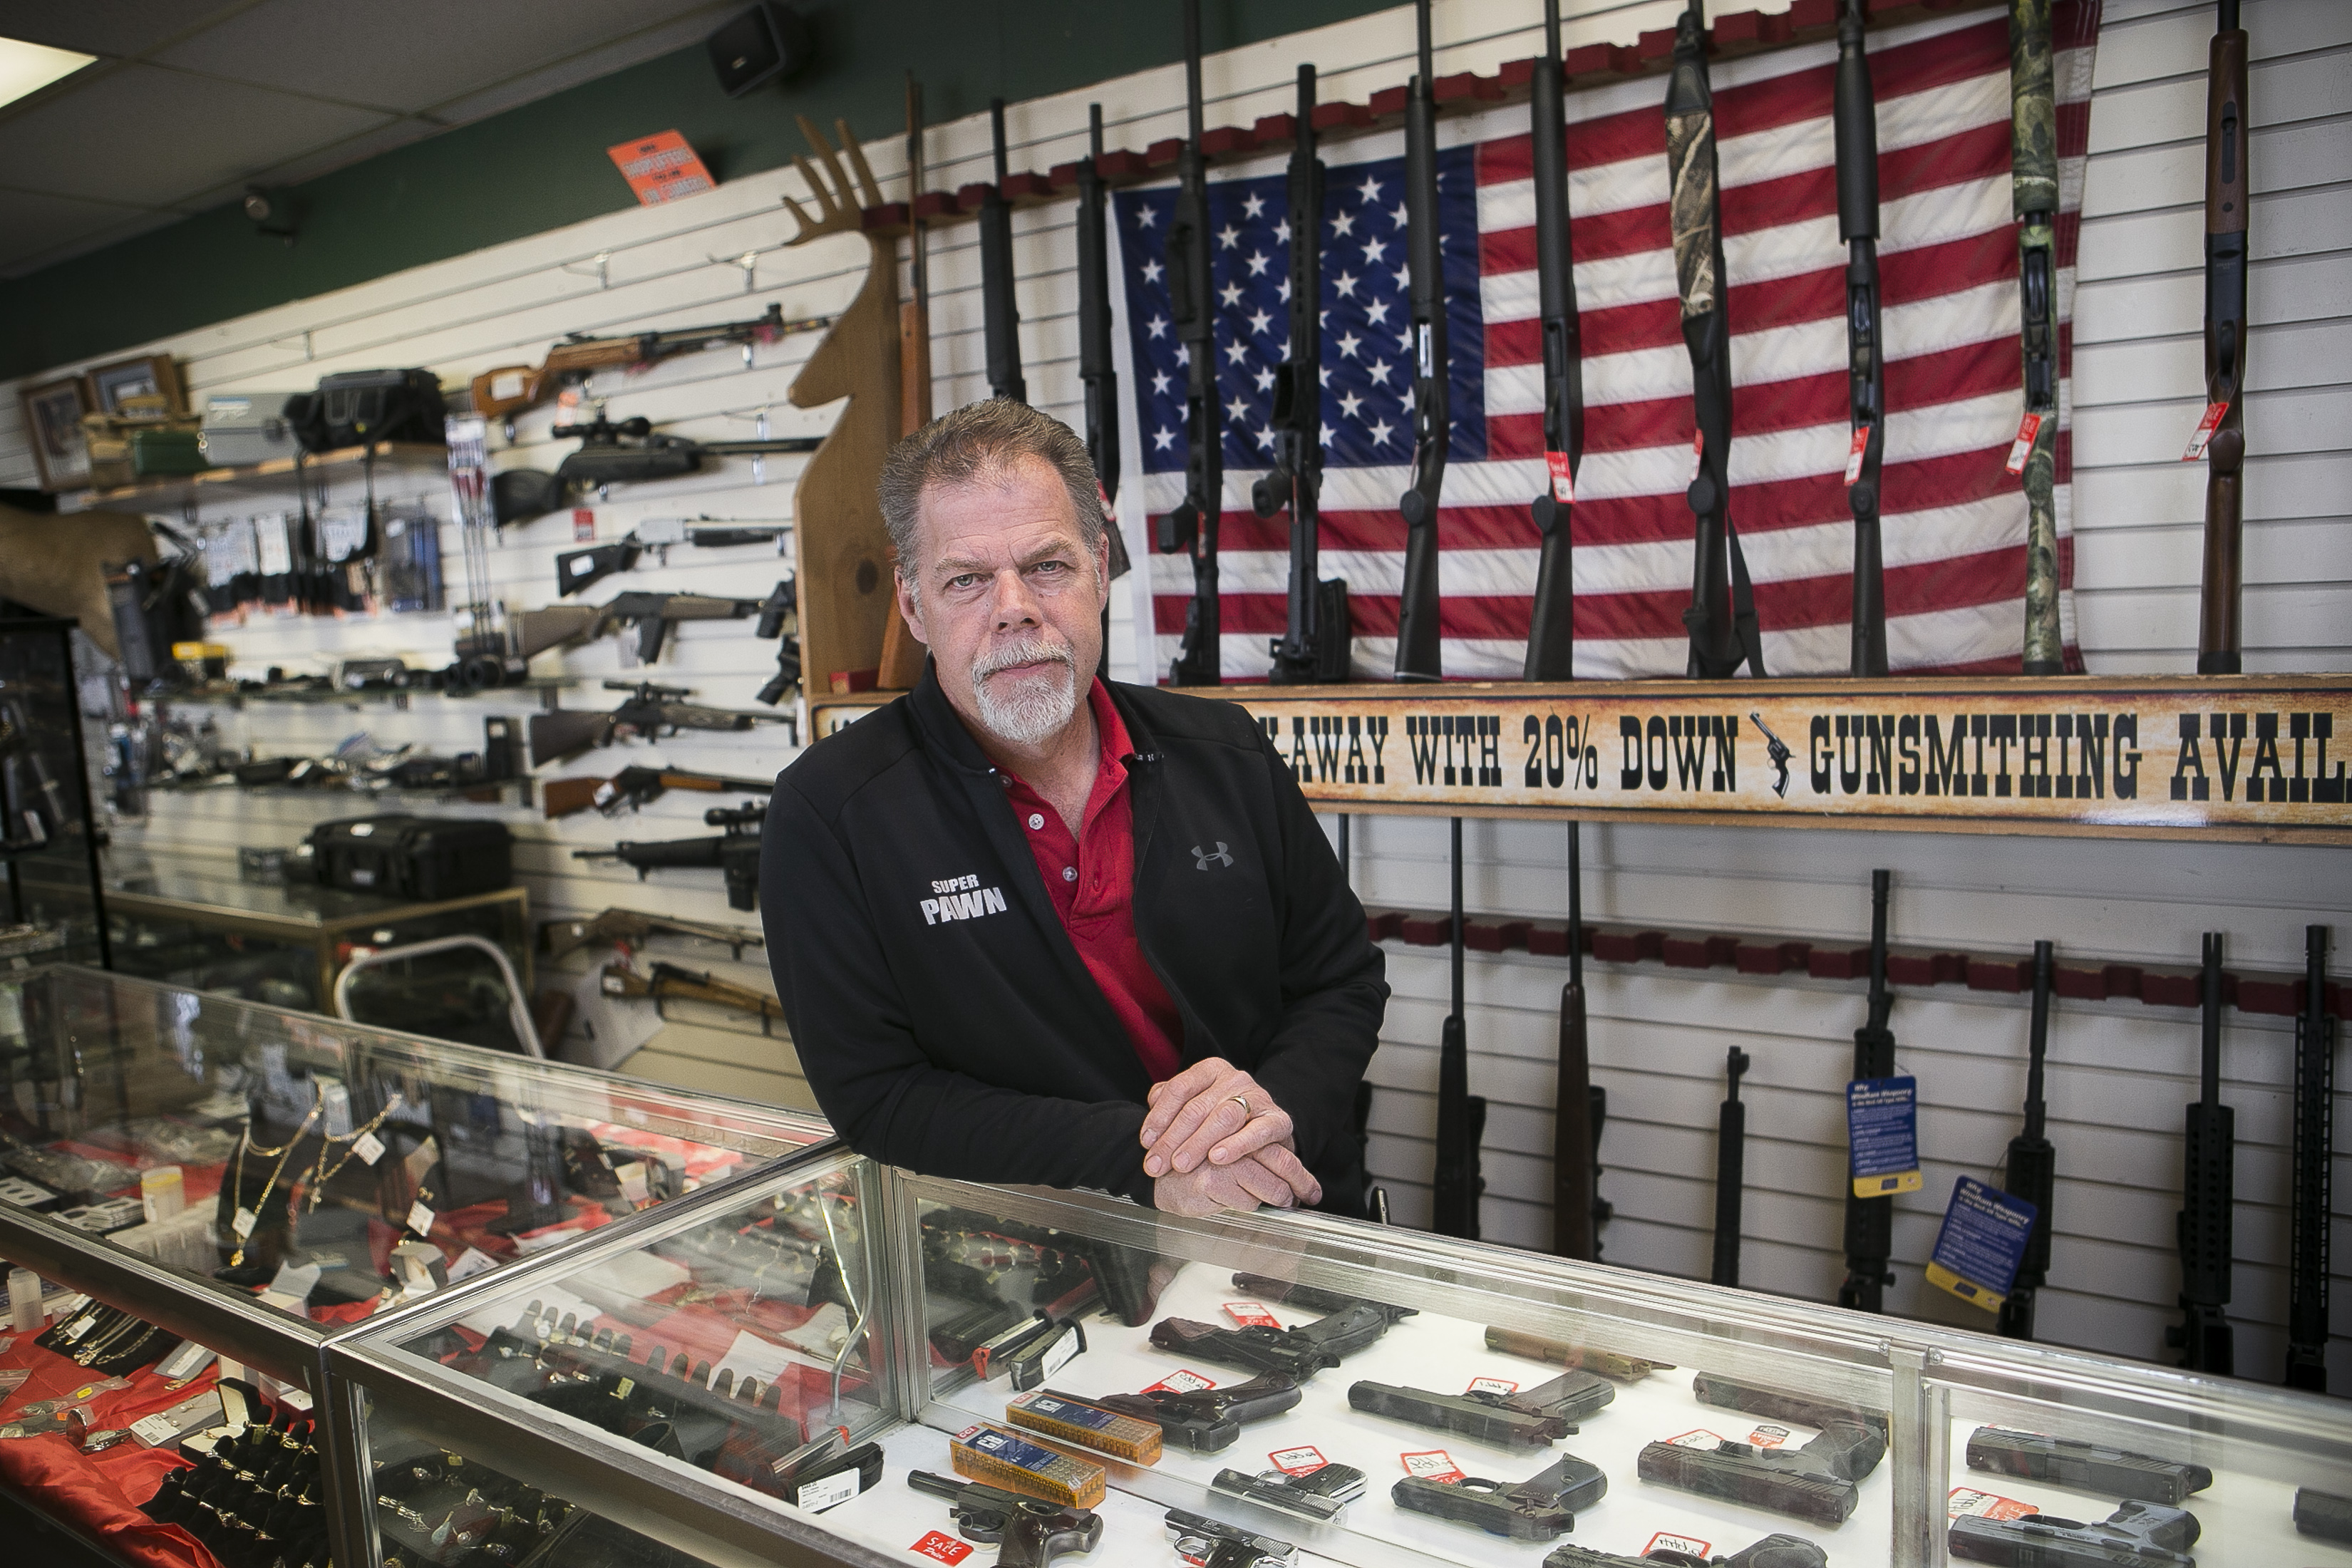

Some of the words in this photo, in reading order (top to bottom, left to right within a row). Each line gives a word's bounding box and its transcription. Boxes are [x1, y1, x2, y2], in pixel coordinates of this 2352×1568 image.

[1406, 715, 1502, 787] WITH
[1523, 713, 1598, 790] 20%
[1619, 715, 1738, 792] DOWN
[1810, 713, 2142, 800] GUNSMITHING
[2170, 712, 2352, 803] AVAIL
[931, 874, 980, 894] SUPER
[919, 887, 1007, 925] PAWN
[959, 1426, 976, 1438] CCI
[976, 1434, 1004, 1451] CB
[923, 1546, 946, 1560] Price
[927, 1536, 959, 1557] SALE
